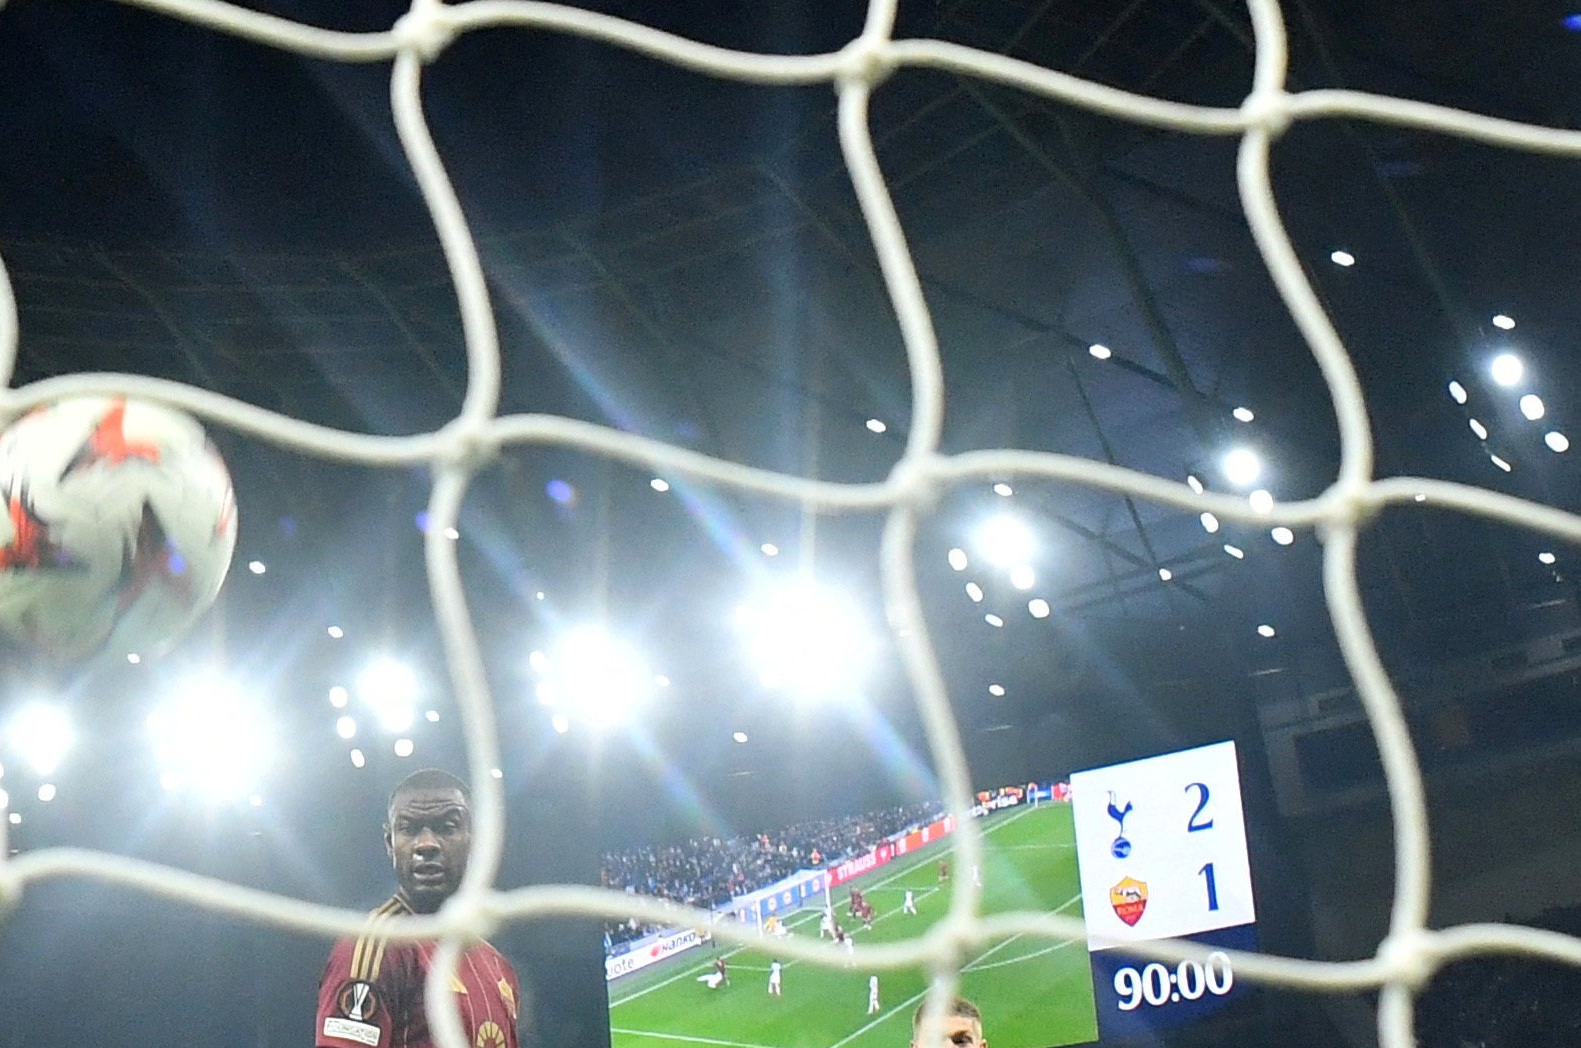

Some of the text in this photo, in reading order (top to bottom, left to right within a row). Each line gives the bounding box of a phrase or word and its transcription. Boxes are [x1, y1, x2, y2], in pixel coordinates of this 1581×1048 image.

[1184, 782, 1214, 832] 2
[1198, 862, 1220, 912] 1
[1114, 951, 1234, 1012] 90:00
